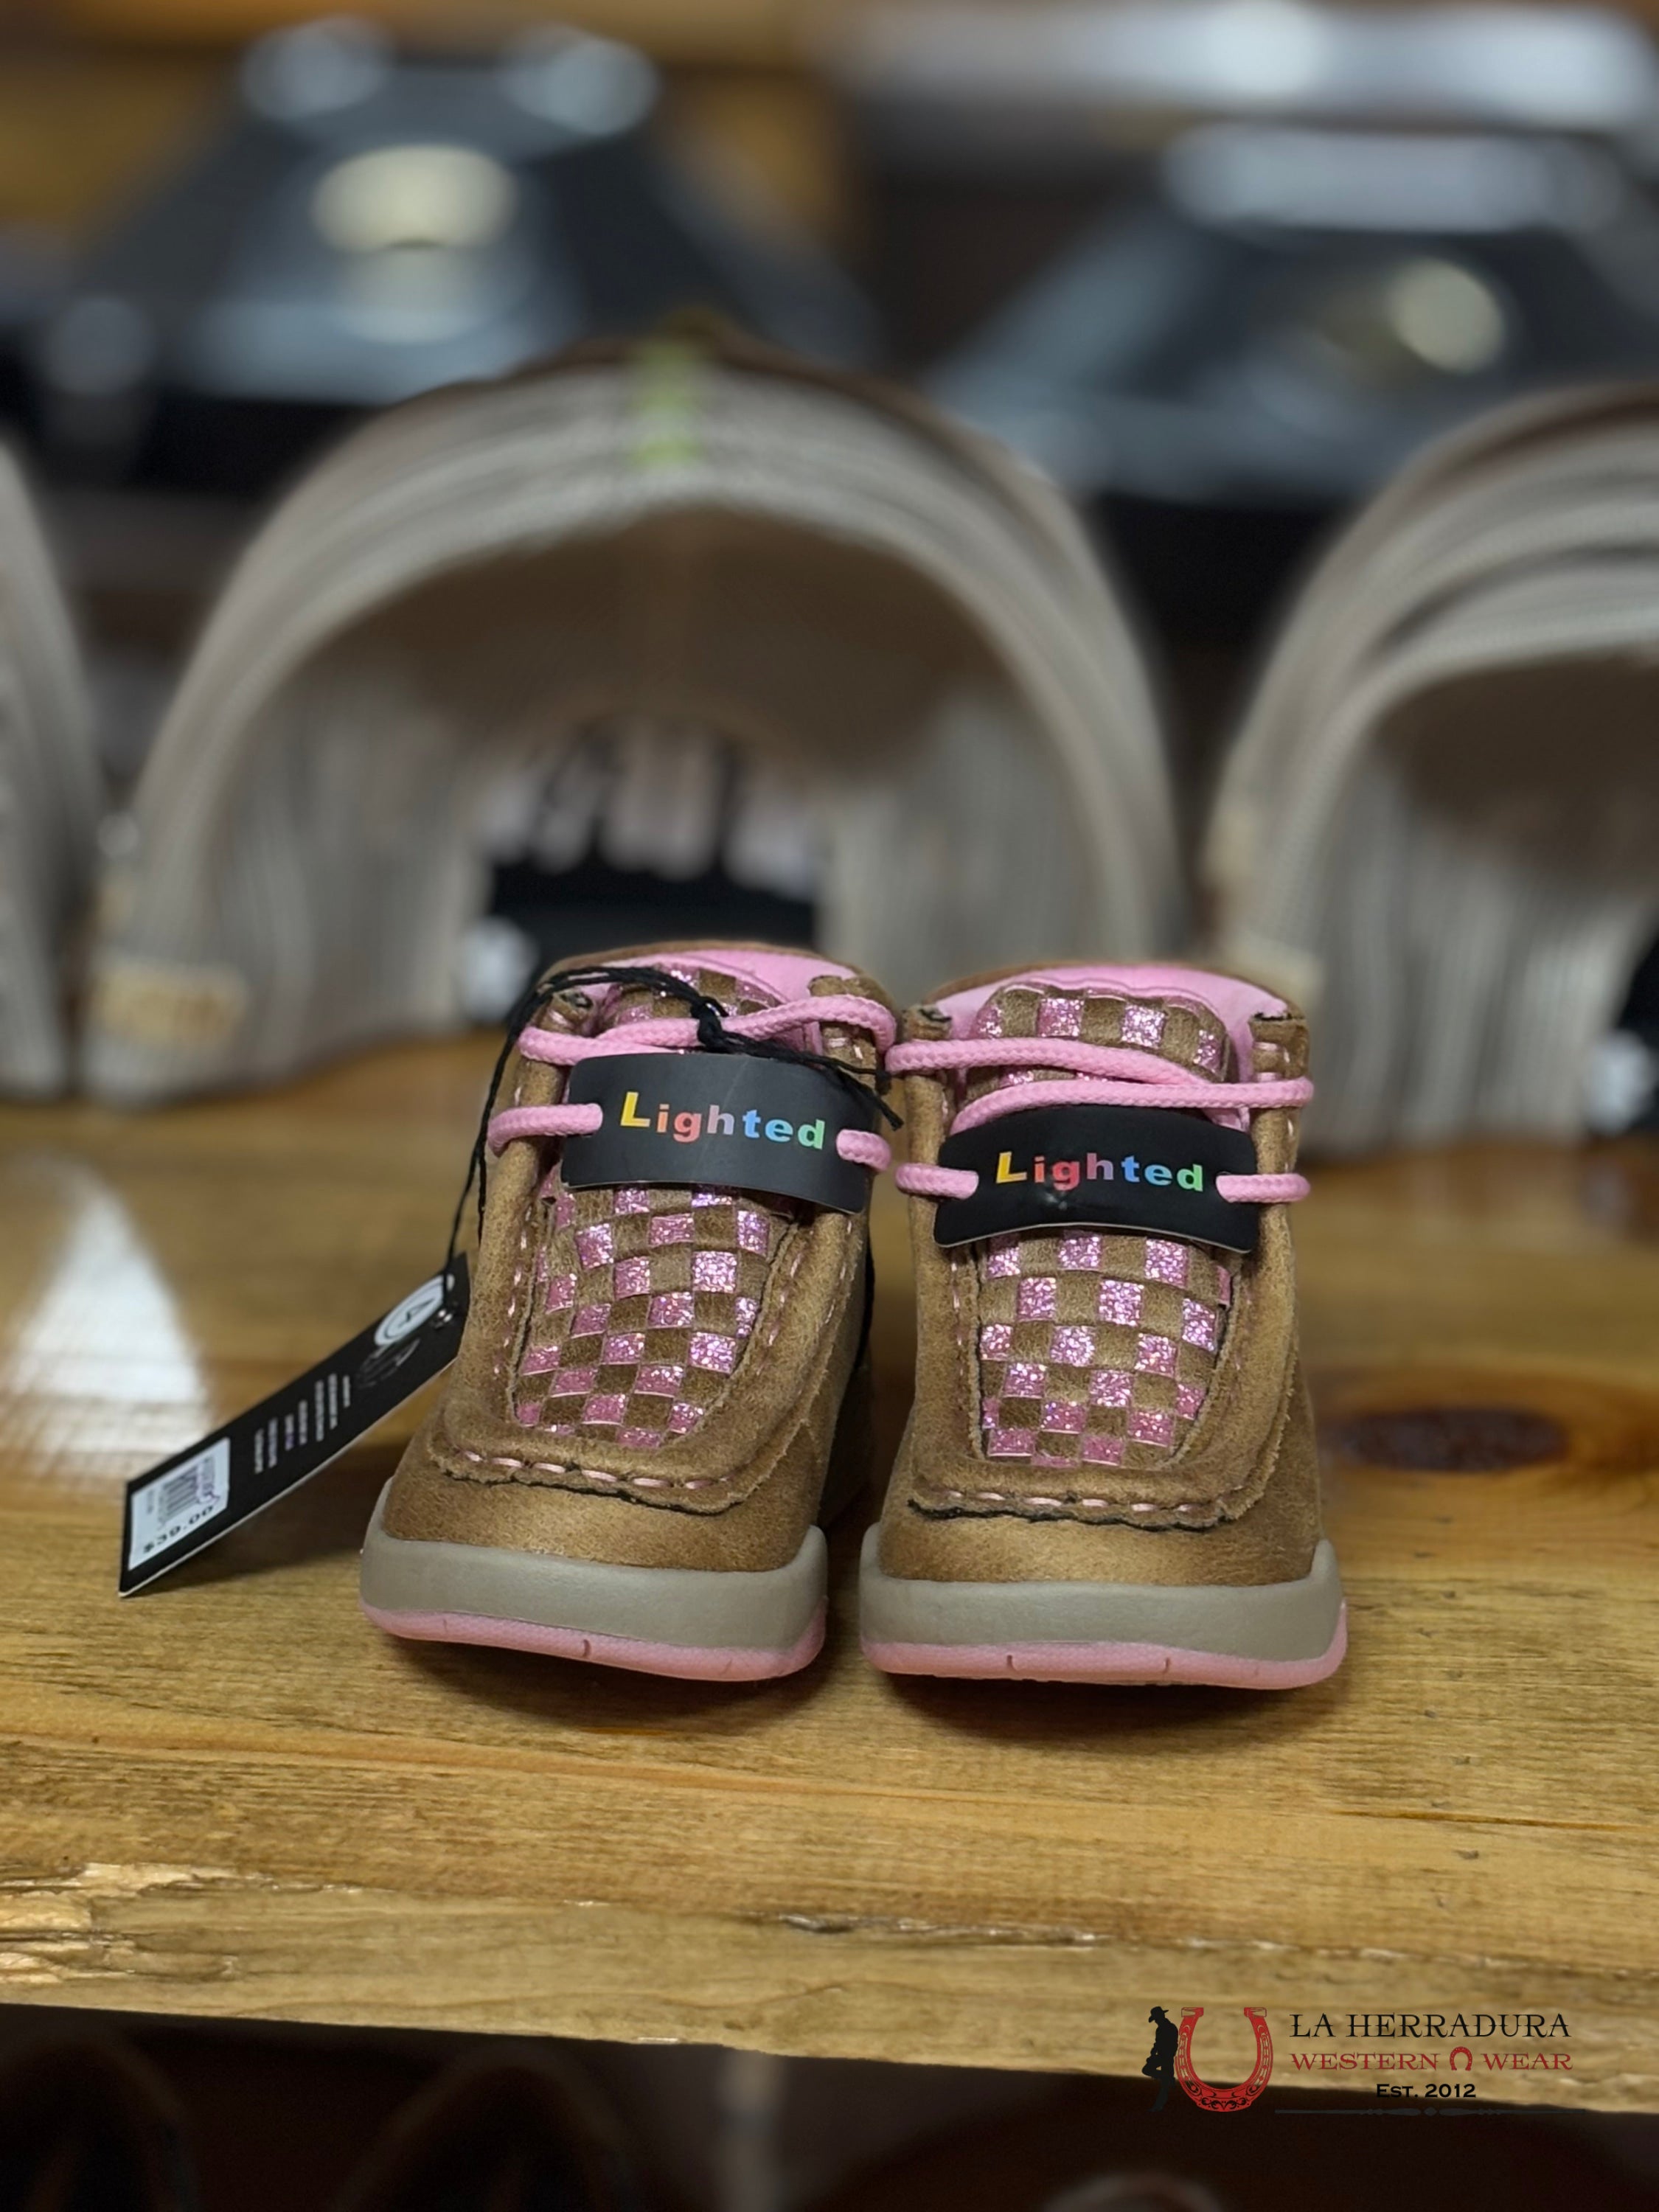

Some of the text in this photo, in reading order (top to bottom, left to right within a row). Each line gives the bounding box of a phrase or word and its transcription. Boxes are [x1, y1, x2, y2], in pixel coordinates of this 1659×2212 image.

[619, 1091, 826, 1150] Lighted
[995, 1151, 1203, 1192] Lighted
[142, 1505, 215, 1554] $39.00
